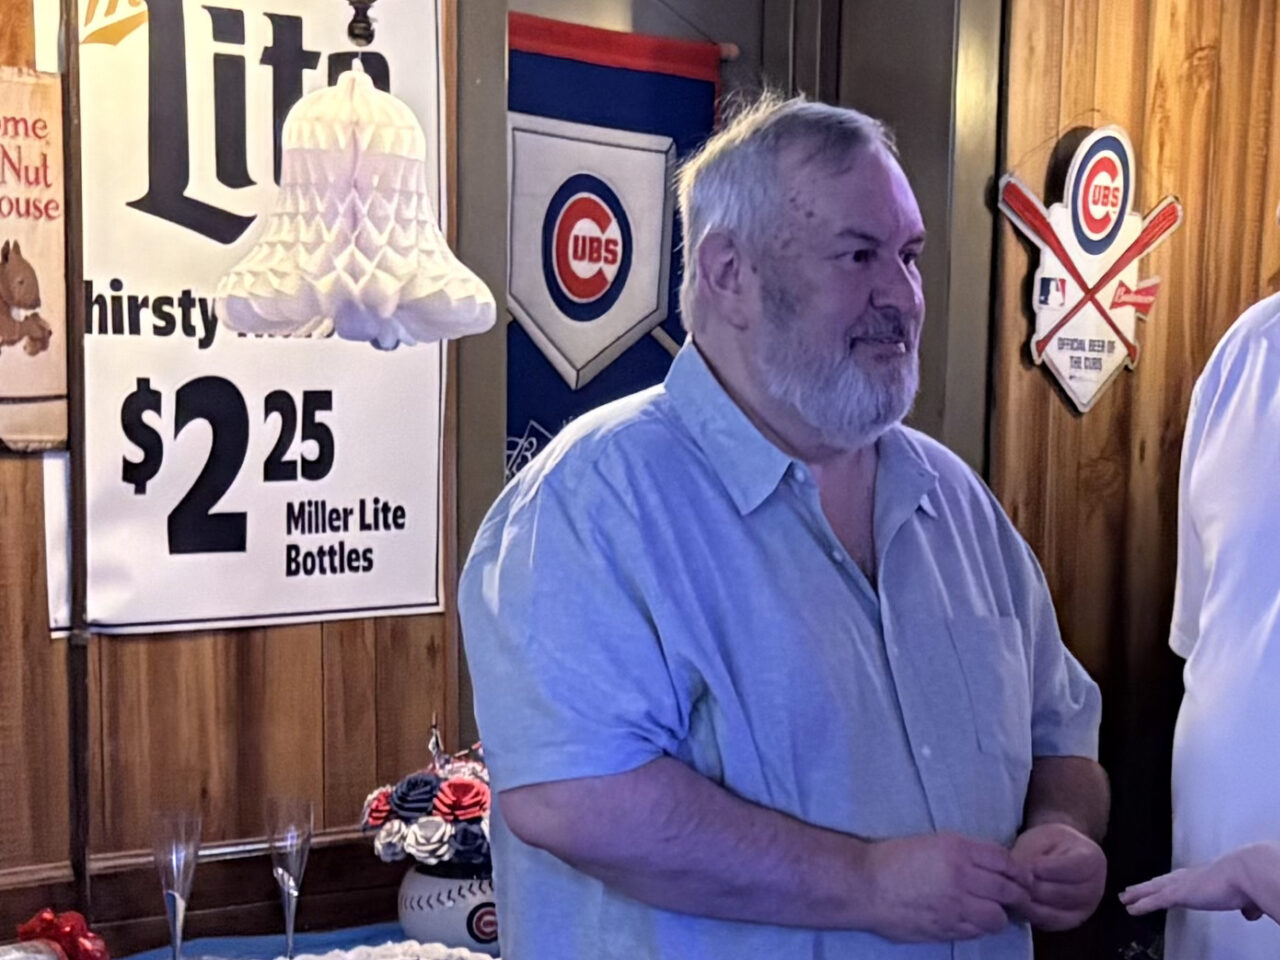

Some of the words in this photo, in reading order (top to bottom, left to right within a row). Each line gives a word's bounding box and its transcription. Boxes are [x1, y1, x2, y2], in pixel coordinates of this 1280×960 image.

[0, 116, 49, 139] me
[0, 143, 52, 188] Nut
[0, 195, 60, 221] ouse
[554, 196, 621, 302] CUBS
[84, 278, 218, 349] hirsty
[286, 502, 353, 535] Miller
[359, 498, 406, 532] Lite
[286, 542, 374, 577] Bottles
